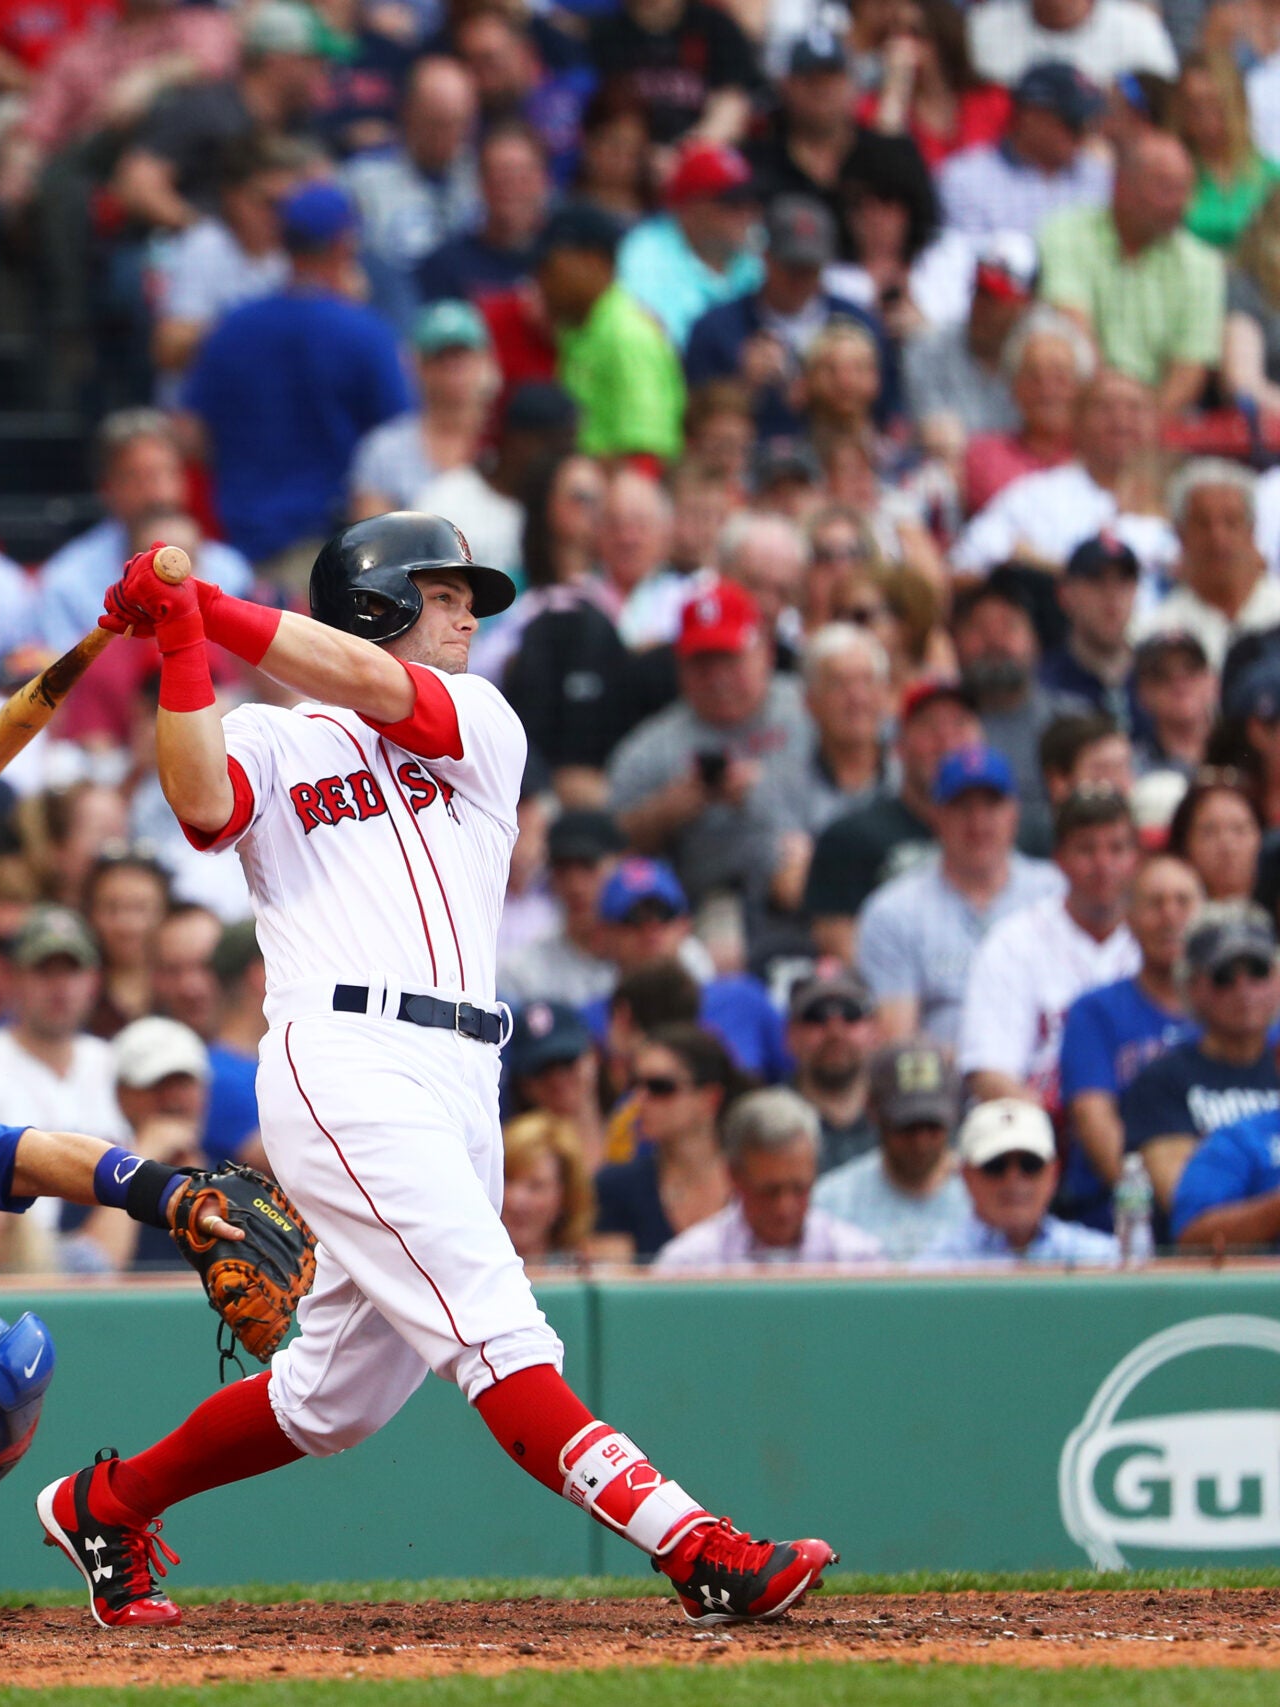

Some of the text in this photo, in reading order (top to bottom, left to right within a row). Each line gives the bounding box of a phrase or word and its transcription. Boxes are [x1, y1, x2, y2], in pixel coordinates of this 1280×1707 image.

[289, 769, 389, 835] RED
[252, 1197, 292, 1232] A2000
[601, 1442, 629, 1467] 16
